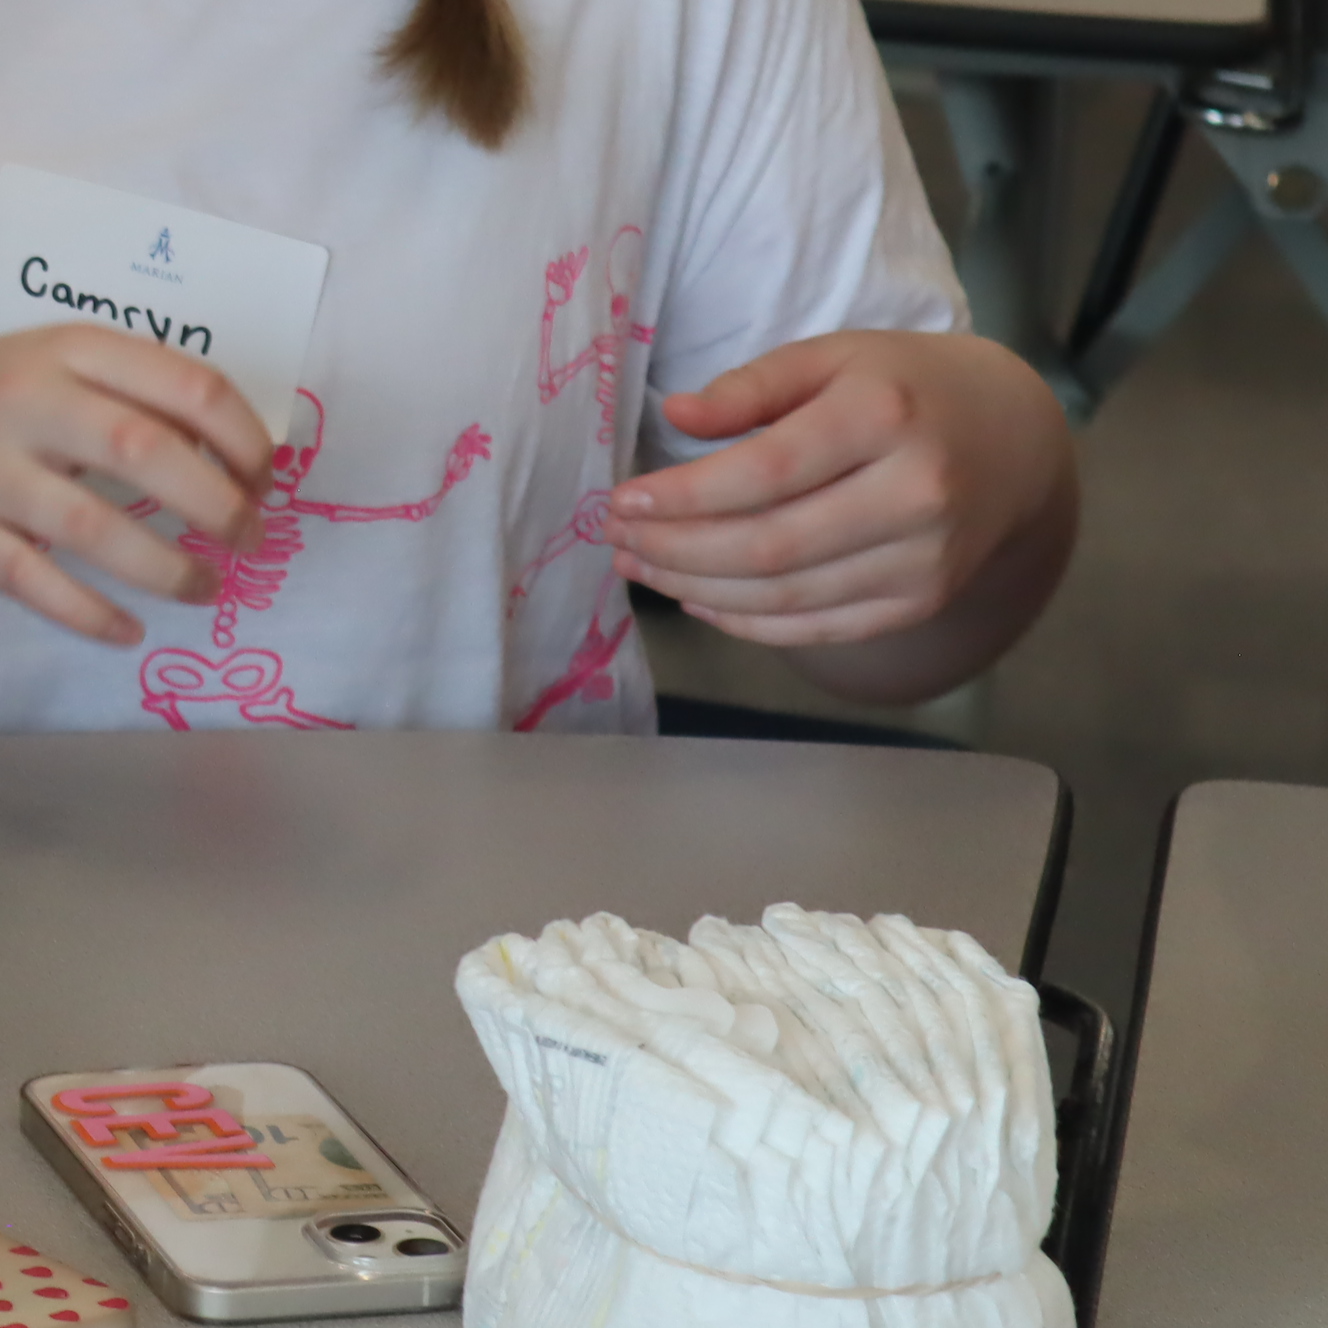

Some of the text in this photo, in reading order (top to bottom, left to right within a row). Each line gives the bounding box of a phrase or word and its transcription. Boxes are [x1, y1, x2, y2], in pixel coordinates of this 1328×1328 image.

[20, 256, 213, 356] Camryn
[129, 261, 183, 285] MARIAN
[50, 1081, 277, 1169] CEV
